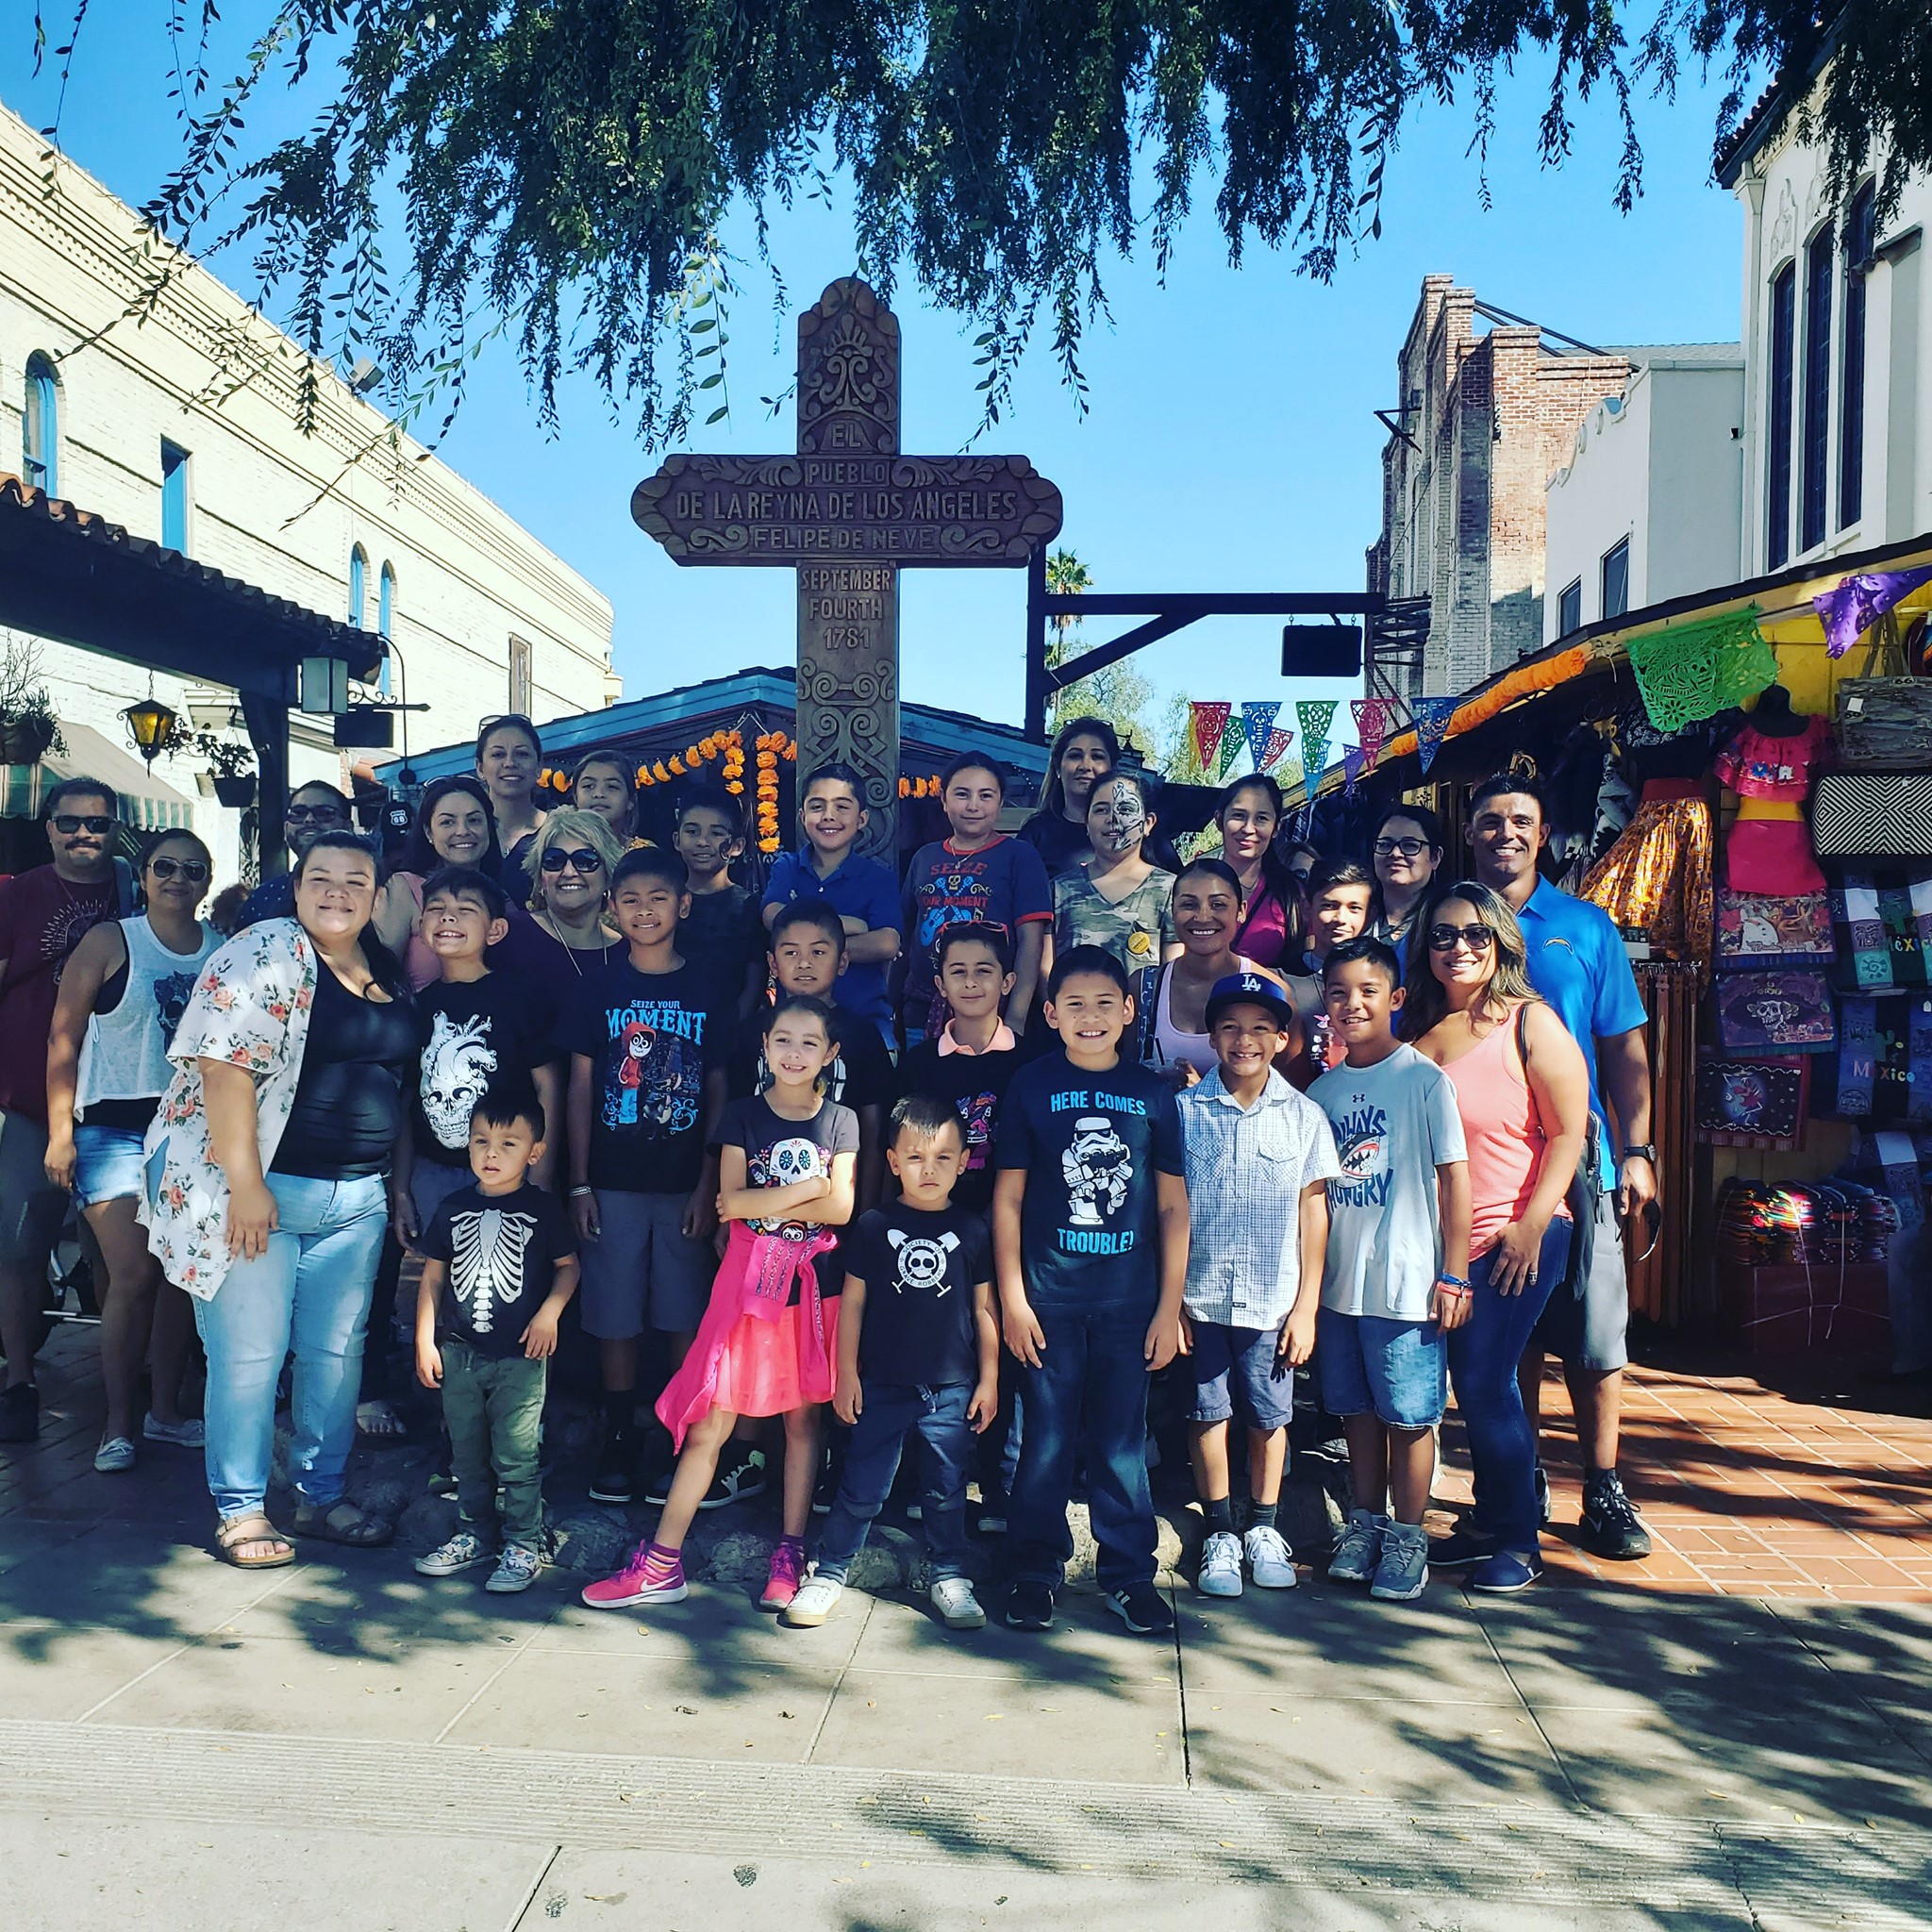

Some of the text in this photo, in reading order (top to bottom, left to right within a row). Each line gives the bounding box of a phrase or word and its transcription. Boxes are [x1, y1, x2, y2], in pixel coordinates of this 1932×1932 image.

[832, 425, 860, 447] EL
[808, 463, 886, 483] PUEBLO
[676, 491, 1017, 520] DE LA REYNA DE LOS ANGELES
[755, 527, 935, 550] FELIPE DE NEVE
[801, 569, 891, 591] SEPTEMBER
[809, 598, 883, 620] FOURTH
[824, 627, 870, 649] 1781
[921, 895, 989, 908] OUR MOMENT
[1241, 974, 1261, 991] LA
[630, 1000, 680, 1009] SEIZE YOUR
[606, 1008, 707, 1046] MOMENT
[1050, 1091, 1146, 1116] HERE COMES
[1326, 1168, 1394, 1213] HUNGRY
[903, 1240, 932, 1254] SOCIETY
[1057, 1227, 1135, 1255] TROUBLE!
[900, 1265, 944, 1286] GRAVE ROBBERS
